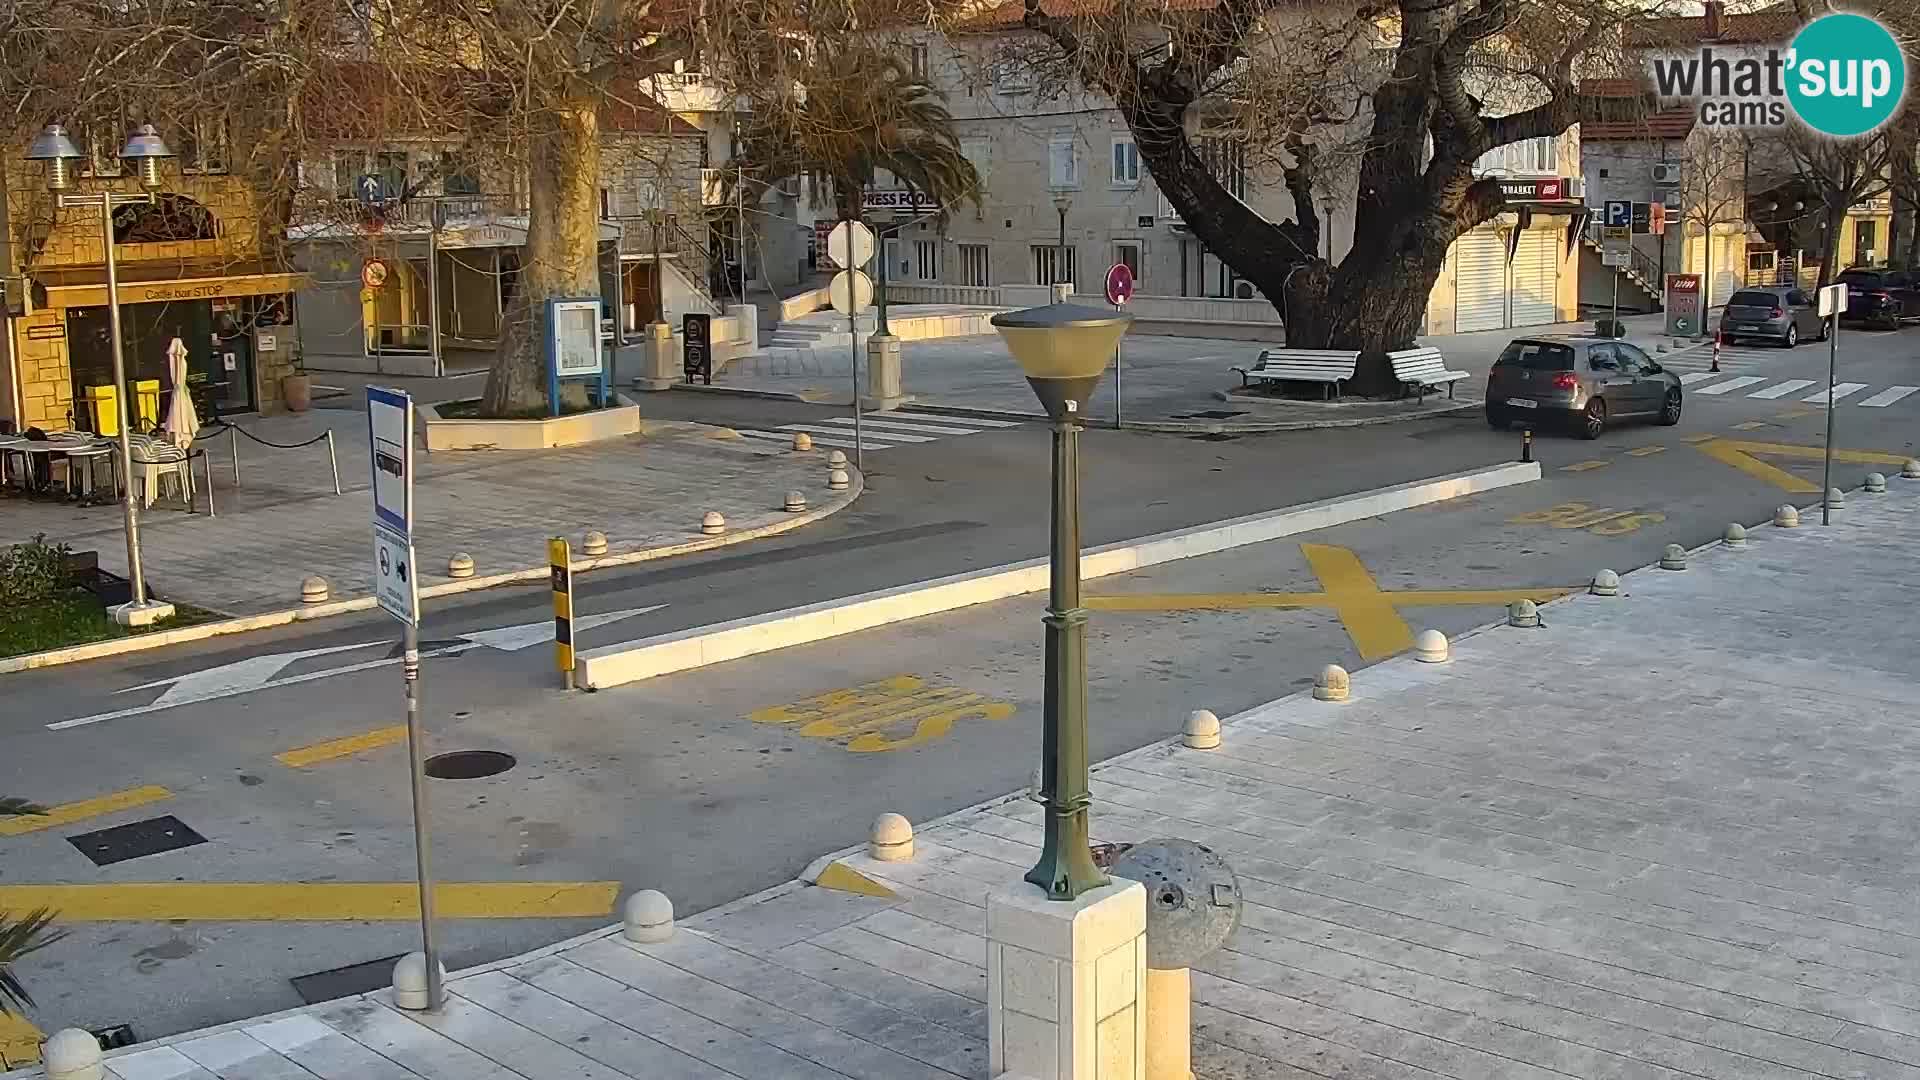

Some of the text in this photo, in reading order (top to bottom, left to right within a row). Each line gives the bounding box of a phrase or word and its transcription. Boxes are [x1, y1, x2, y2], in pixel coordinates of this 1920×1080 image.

[1500, 184, 1536, 195] RMARKET
[1609, 202, 1624, 225] P
[174, 288, 191, 298] bar
[193, 285, 224, 297] STOP
